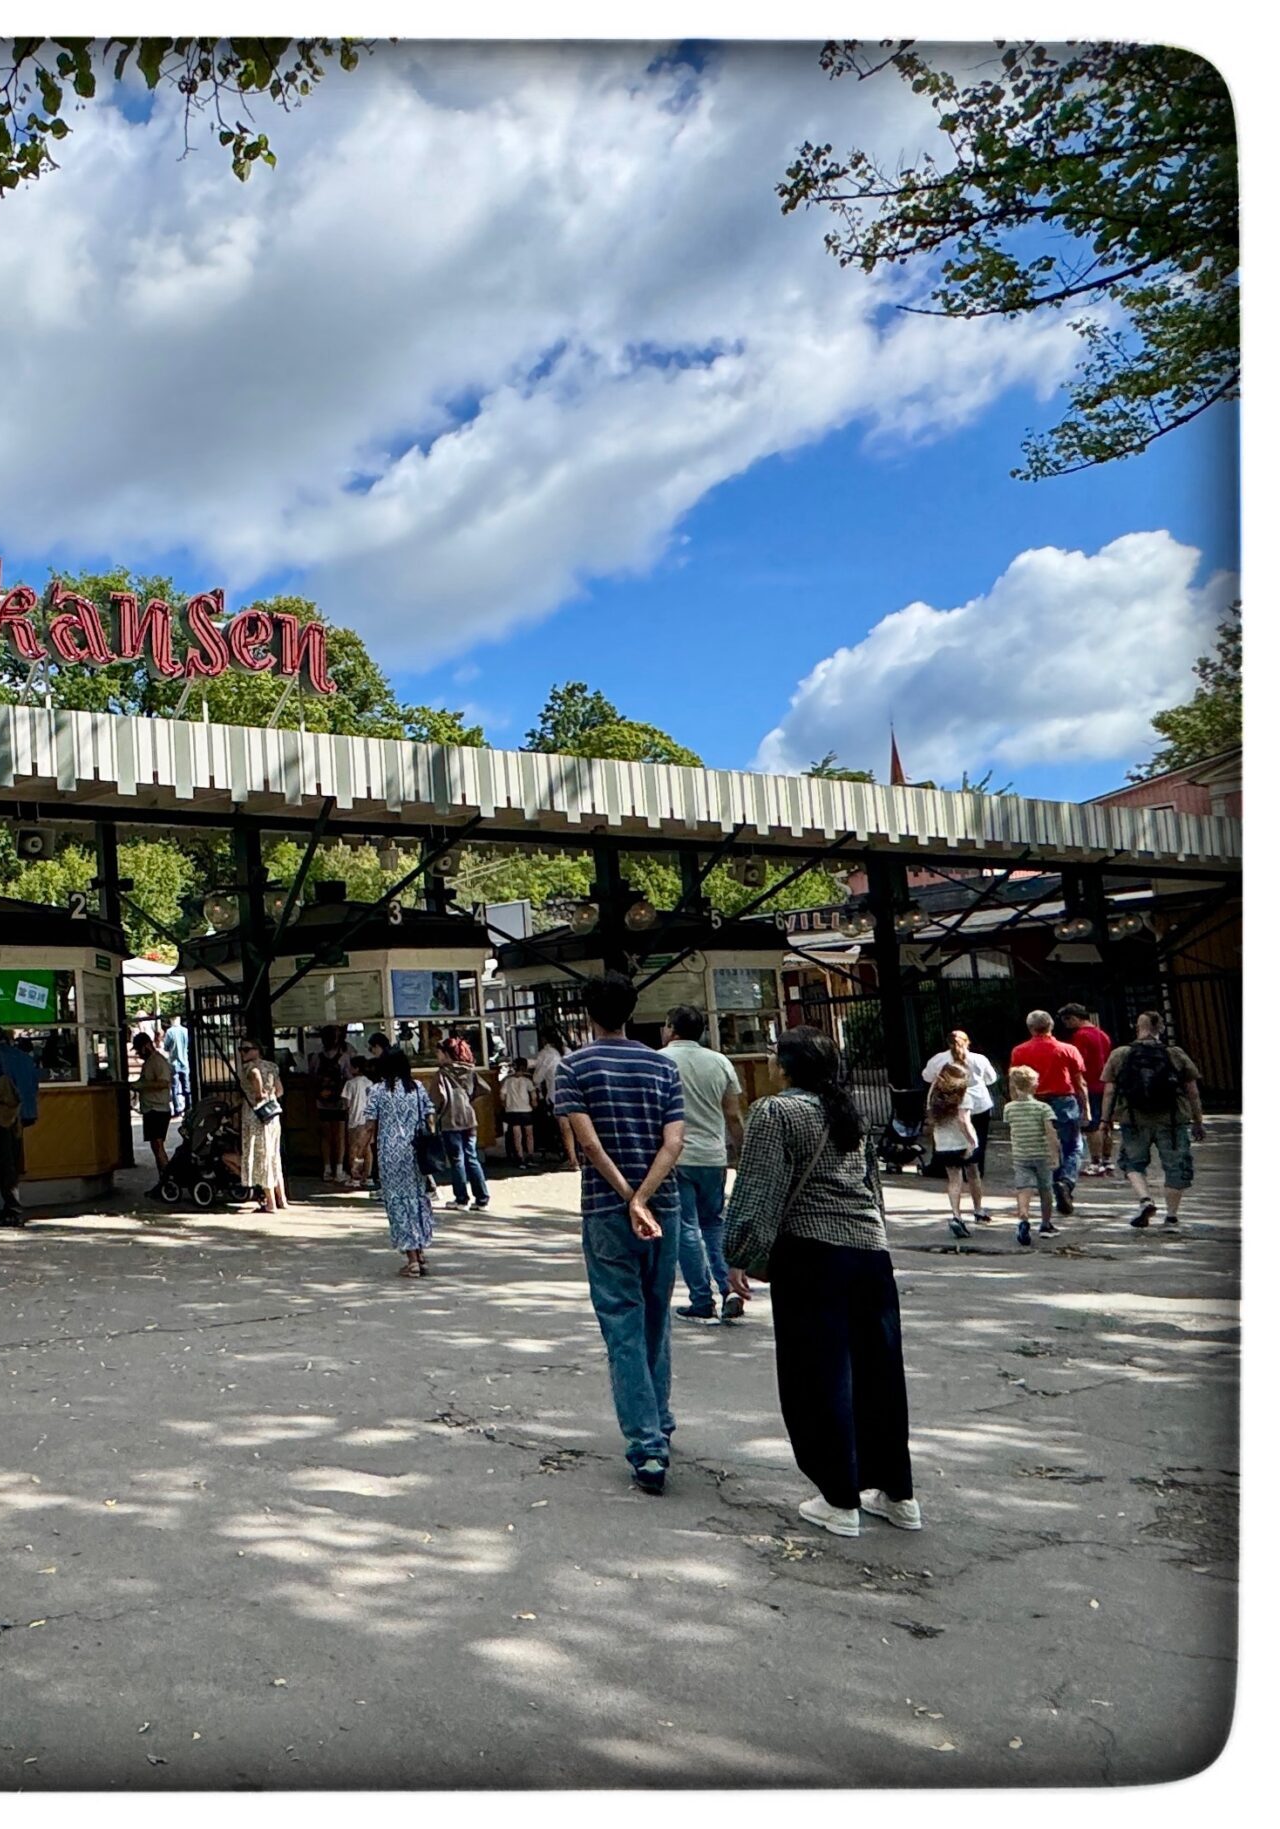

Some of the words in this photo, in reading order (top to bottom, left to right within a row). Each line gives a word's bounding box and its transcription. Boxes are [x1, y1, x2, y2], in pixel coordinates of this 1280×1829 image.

[70, 893, 87, 919] 2
[389, 901, 403, 925] 3
[473, 904, 487, 925] 4
[710, 912, 722, 930] 5
[775, 911, 785, 930] 6
